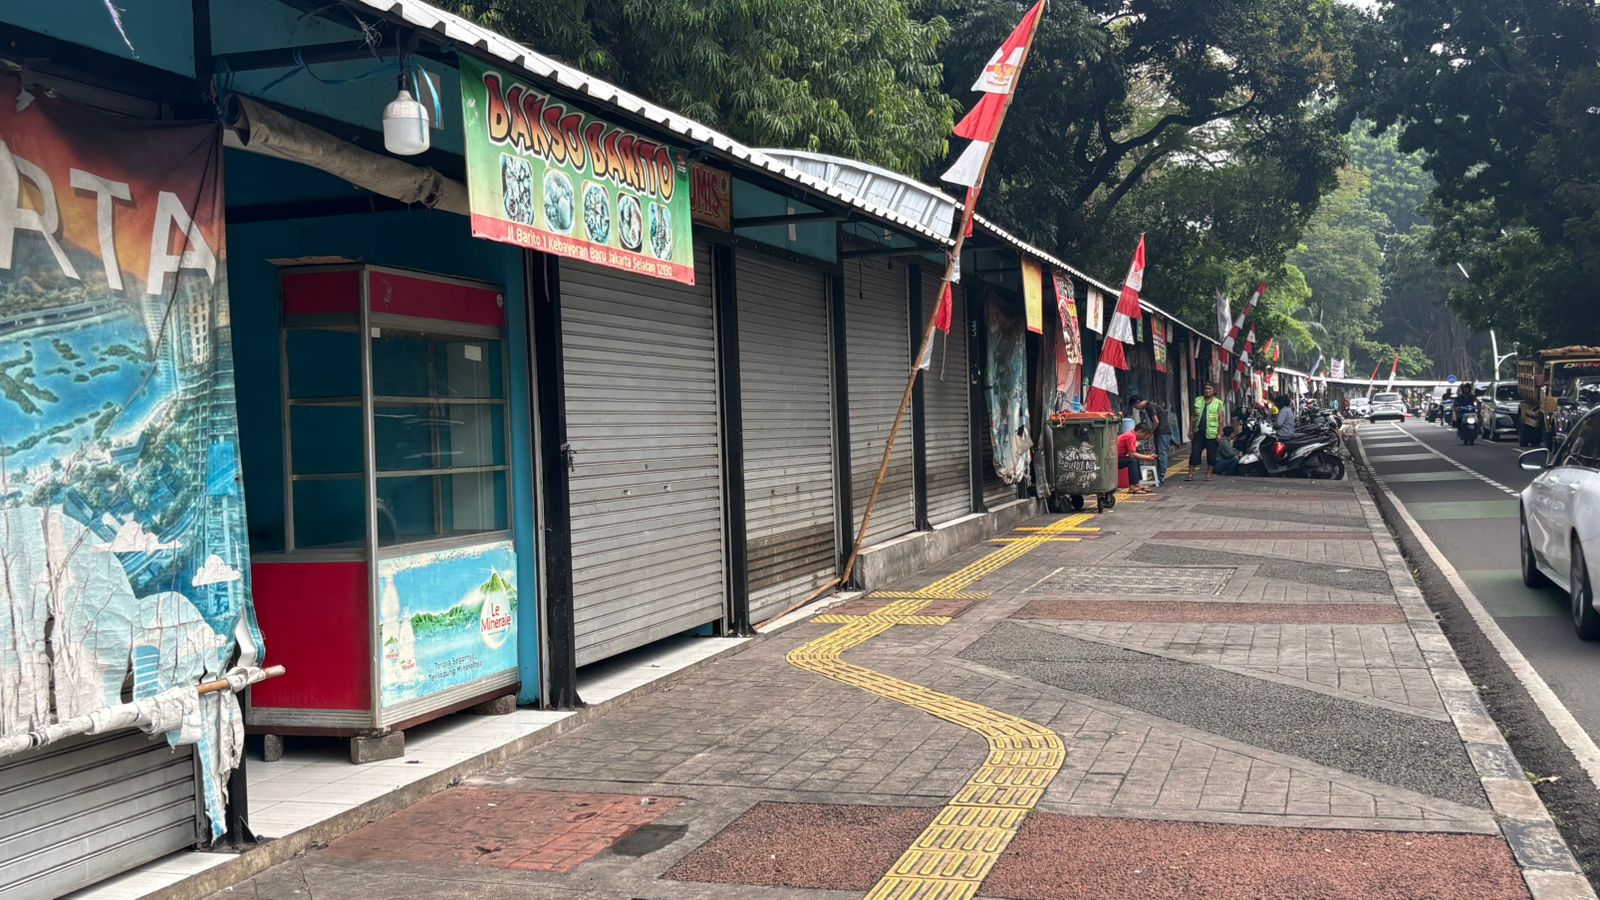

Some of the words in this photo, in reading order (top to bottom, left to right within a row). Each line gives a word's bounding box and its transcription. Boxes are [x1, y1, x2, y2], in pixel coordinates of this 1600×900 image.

[483, 72, 585, 171] BAKSO
[584, 122, 674, 201] BARITO
[516, 228, 541, 246] Barito
[549, 237, 589, 258] Kebayoran
[590, 247, 607, 262] Baru
[609, 251, 632, 268] Jakarta
[633, 257, 656, 273] Selatan
[481, 613, 511, 632] Minerale
[491, 602, 500, 617] Le
